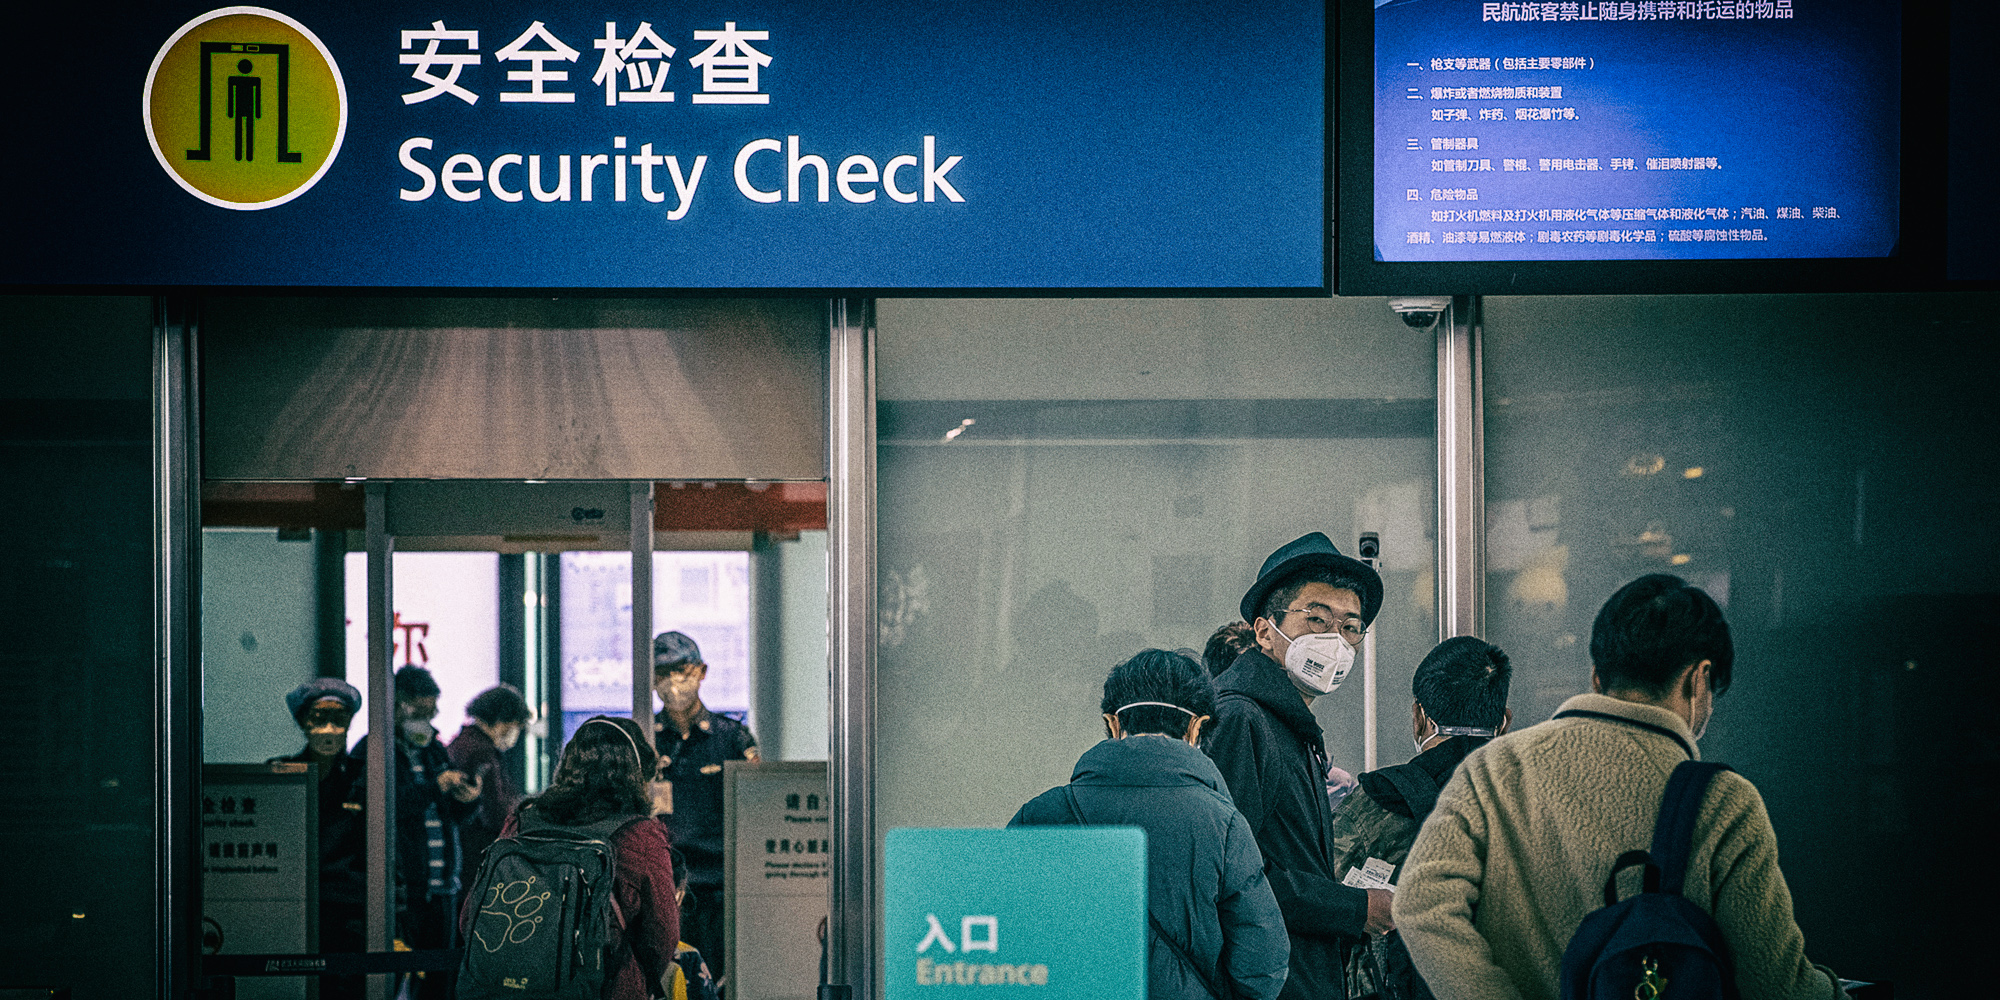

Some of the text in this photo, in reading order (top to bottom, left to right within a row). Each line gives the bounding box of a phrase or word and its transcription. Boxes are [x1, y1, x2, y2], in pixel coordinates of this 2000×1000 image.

[1482, 0, 1794, 22] 民航旅客禁止随身携带和托运的物品
[399, 20, 773, 107] 安全检查
[1406, 86, 1563, 100] 二、爆炸或者燃烧物质和装置
[1431, 107, 1580, 122] 如子弹、炸药、烟花爆竹等。
[1406, 137, 1479, 151] 三、管制器具
[398, 134, 965, 221] Security Check
[1406, 188, 1479, 201] 四、危险物品
[916, 913, 998, 952] 入口
[916, 958, 1048, 985] Entrance
